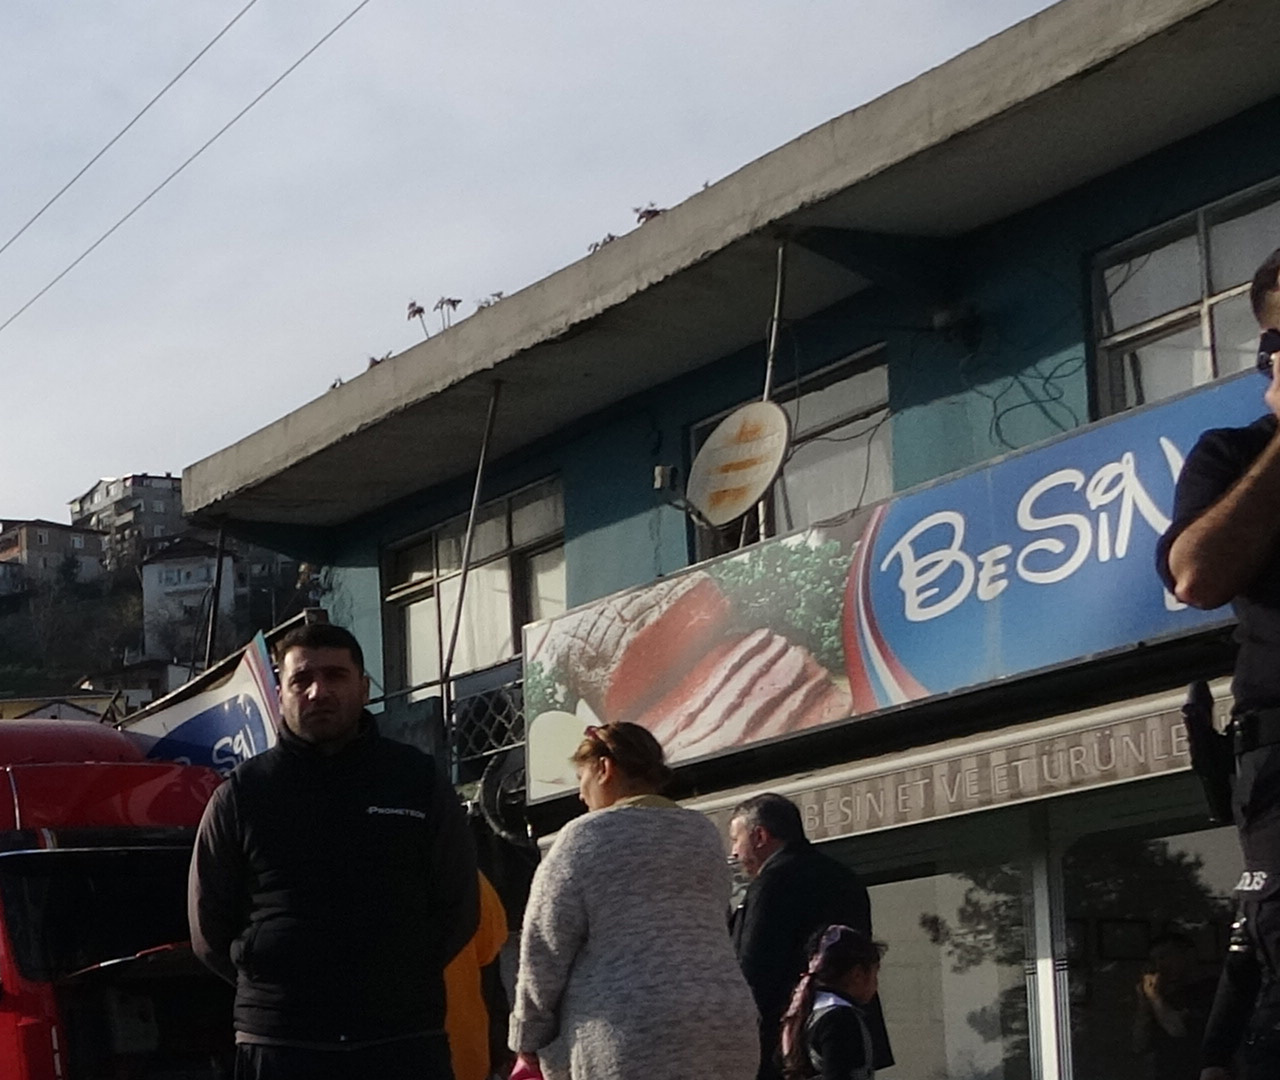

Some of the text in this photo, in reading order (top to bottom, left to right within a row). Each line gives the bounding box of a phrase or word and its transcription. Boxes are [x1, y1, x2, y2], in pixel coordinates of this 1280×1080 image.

[803, 780, 885, 832] BESİN
[896, 778, 930, 813] ET
[940, 767, 981, 804] VE
[992, 758, 1030, 795] ET
